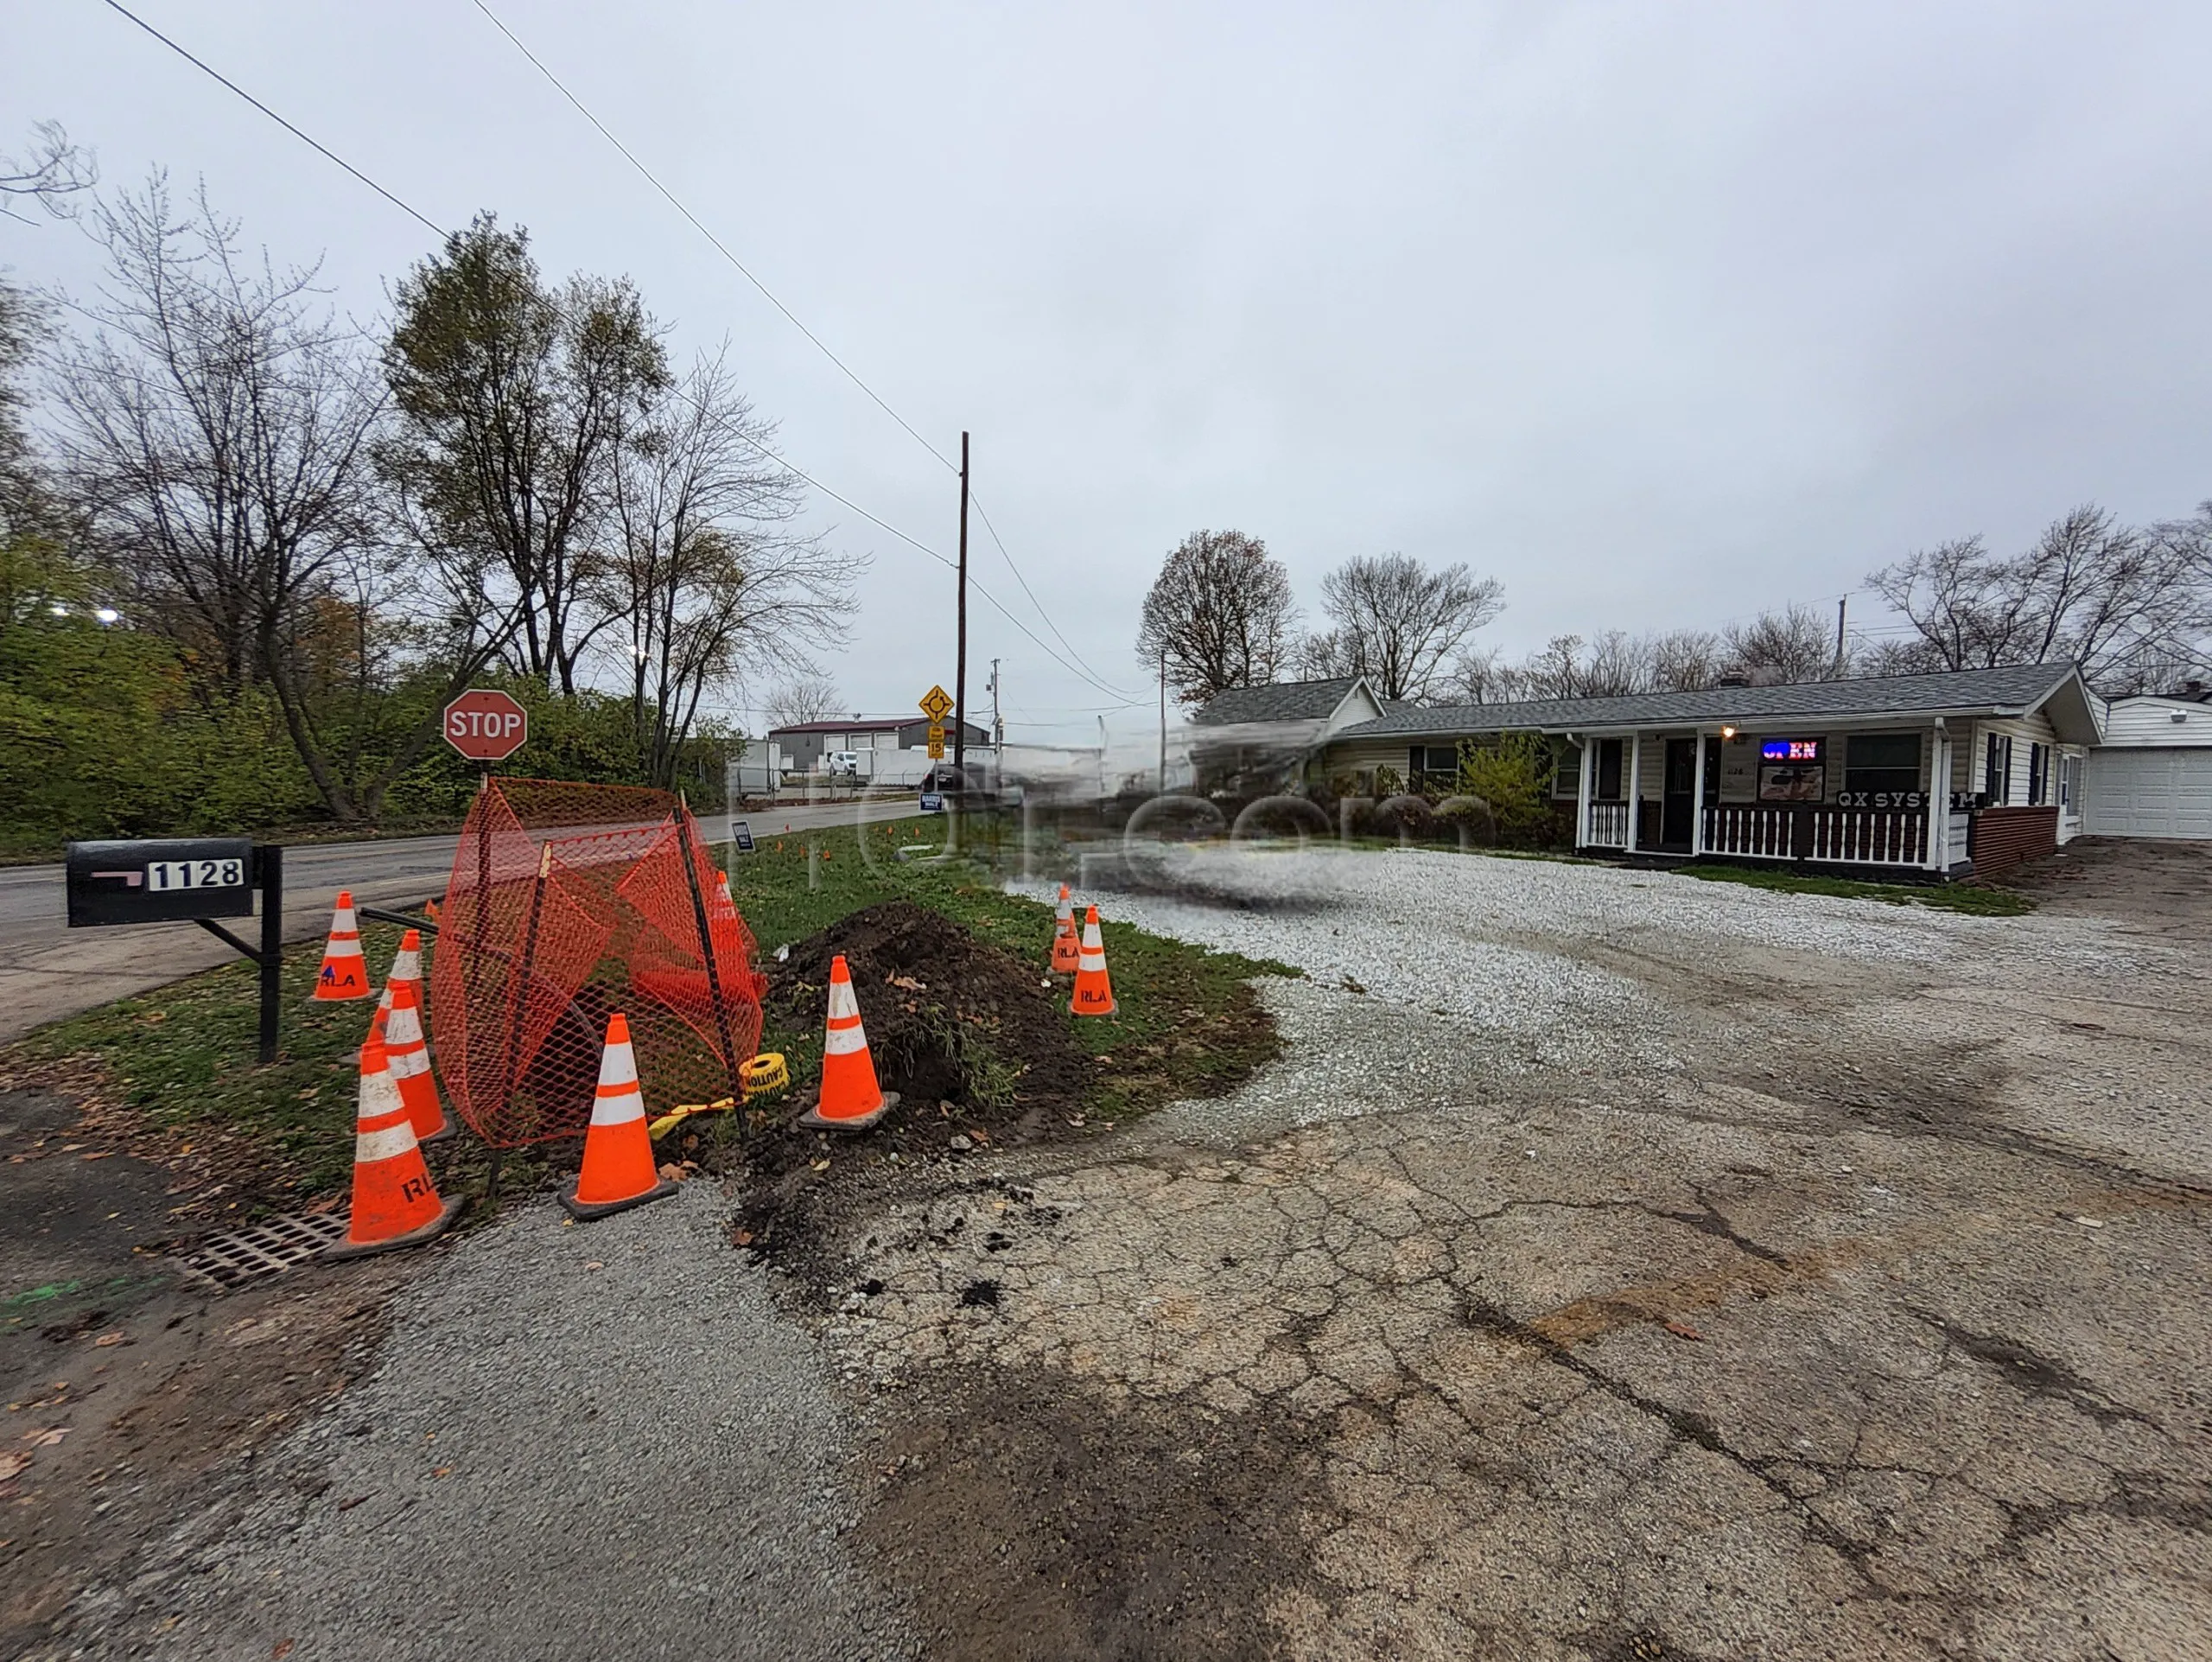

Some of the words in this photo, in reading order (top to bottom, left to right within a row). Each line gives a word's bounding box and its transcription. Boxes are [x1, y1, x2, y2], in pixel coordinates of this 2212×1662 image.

[449, 710, 521, 738] STOP
[931, 742, 942, 753] 15
[1763, 741, 1817, 761] OPEN
[1838, 792, 1869, 807] QX
[154, 861, 240, 888] 1128
[1080, 989, 1108, 1003] RLA
